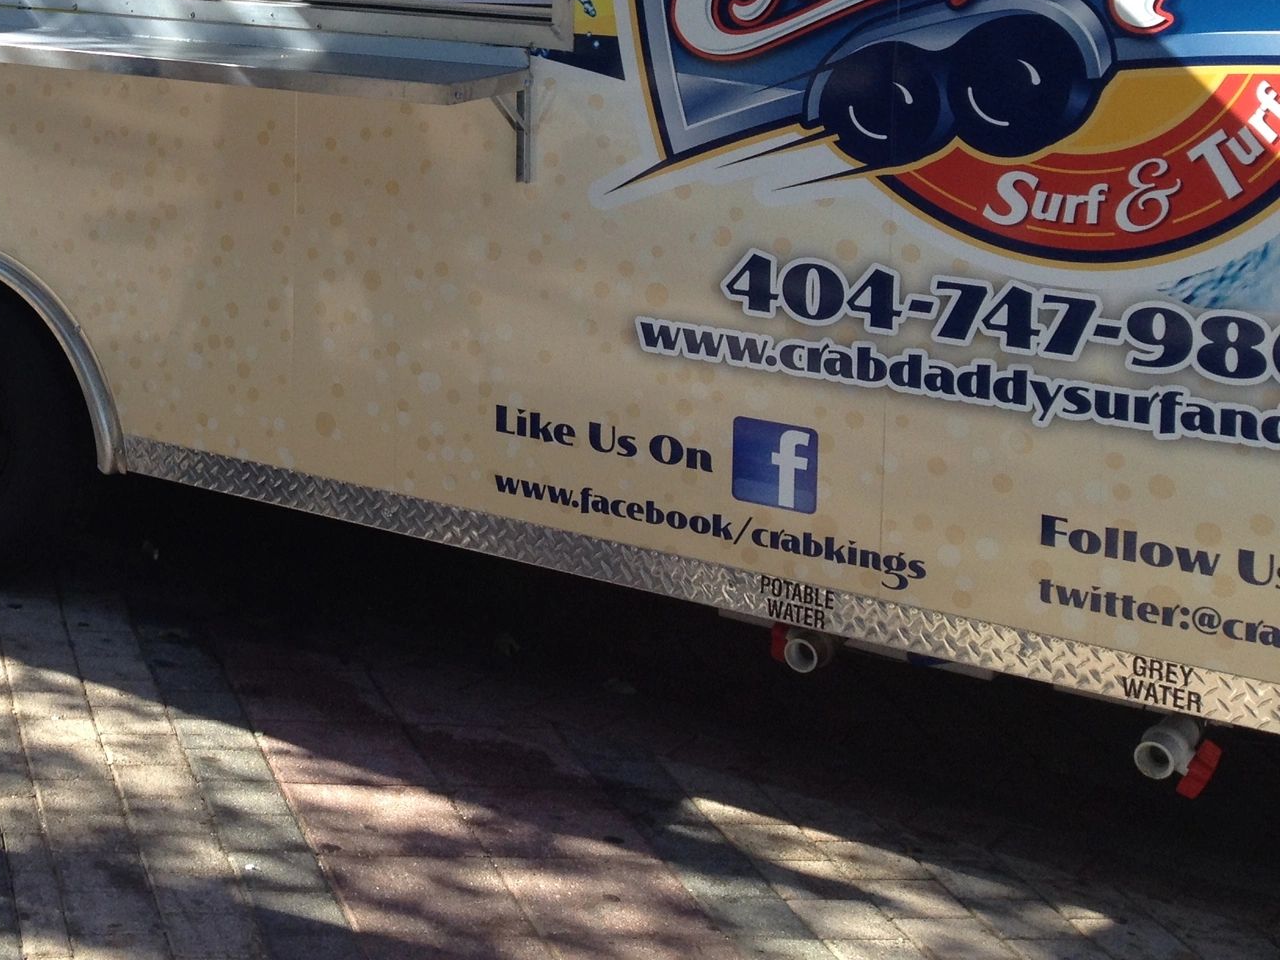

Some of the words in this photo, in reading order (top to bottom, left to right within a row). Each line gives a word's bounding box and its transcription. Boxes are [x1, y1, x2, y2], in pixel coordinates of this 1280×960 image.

[982, 170, 1109, 225] Surf
[1114, 157, 1182, 233] &
[724, 252, 1280, 381] 404-747-98
[494, 404, 576, 447] Like
[588, 420, 638, 458] Us
[649, 433, 714, 473] On
[494, 473, 927, 591] www.facebook/crabkings
[1040, 513, 1221, 577] Follow
[1237, 547, 1280, 590] U
[759, 574, 836, 611] POTABLE
[766, 597, 826, 631] WATER
[1121, 676, 1202, 714] WATER
[1132, 655, 1194, 687] GREY
